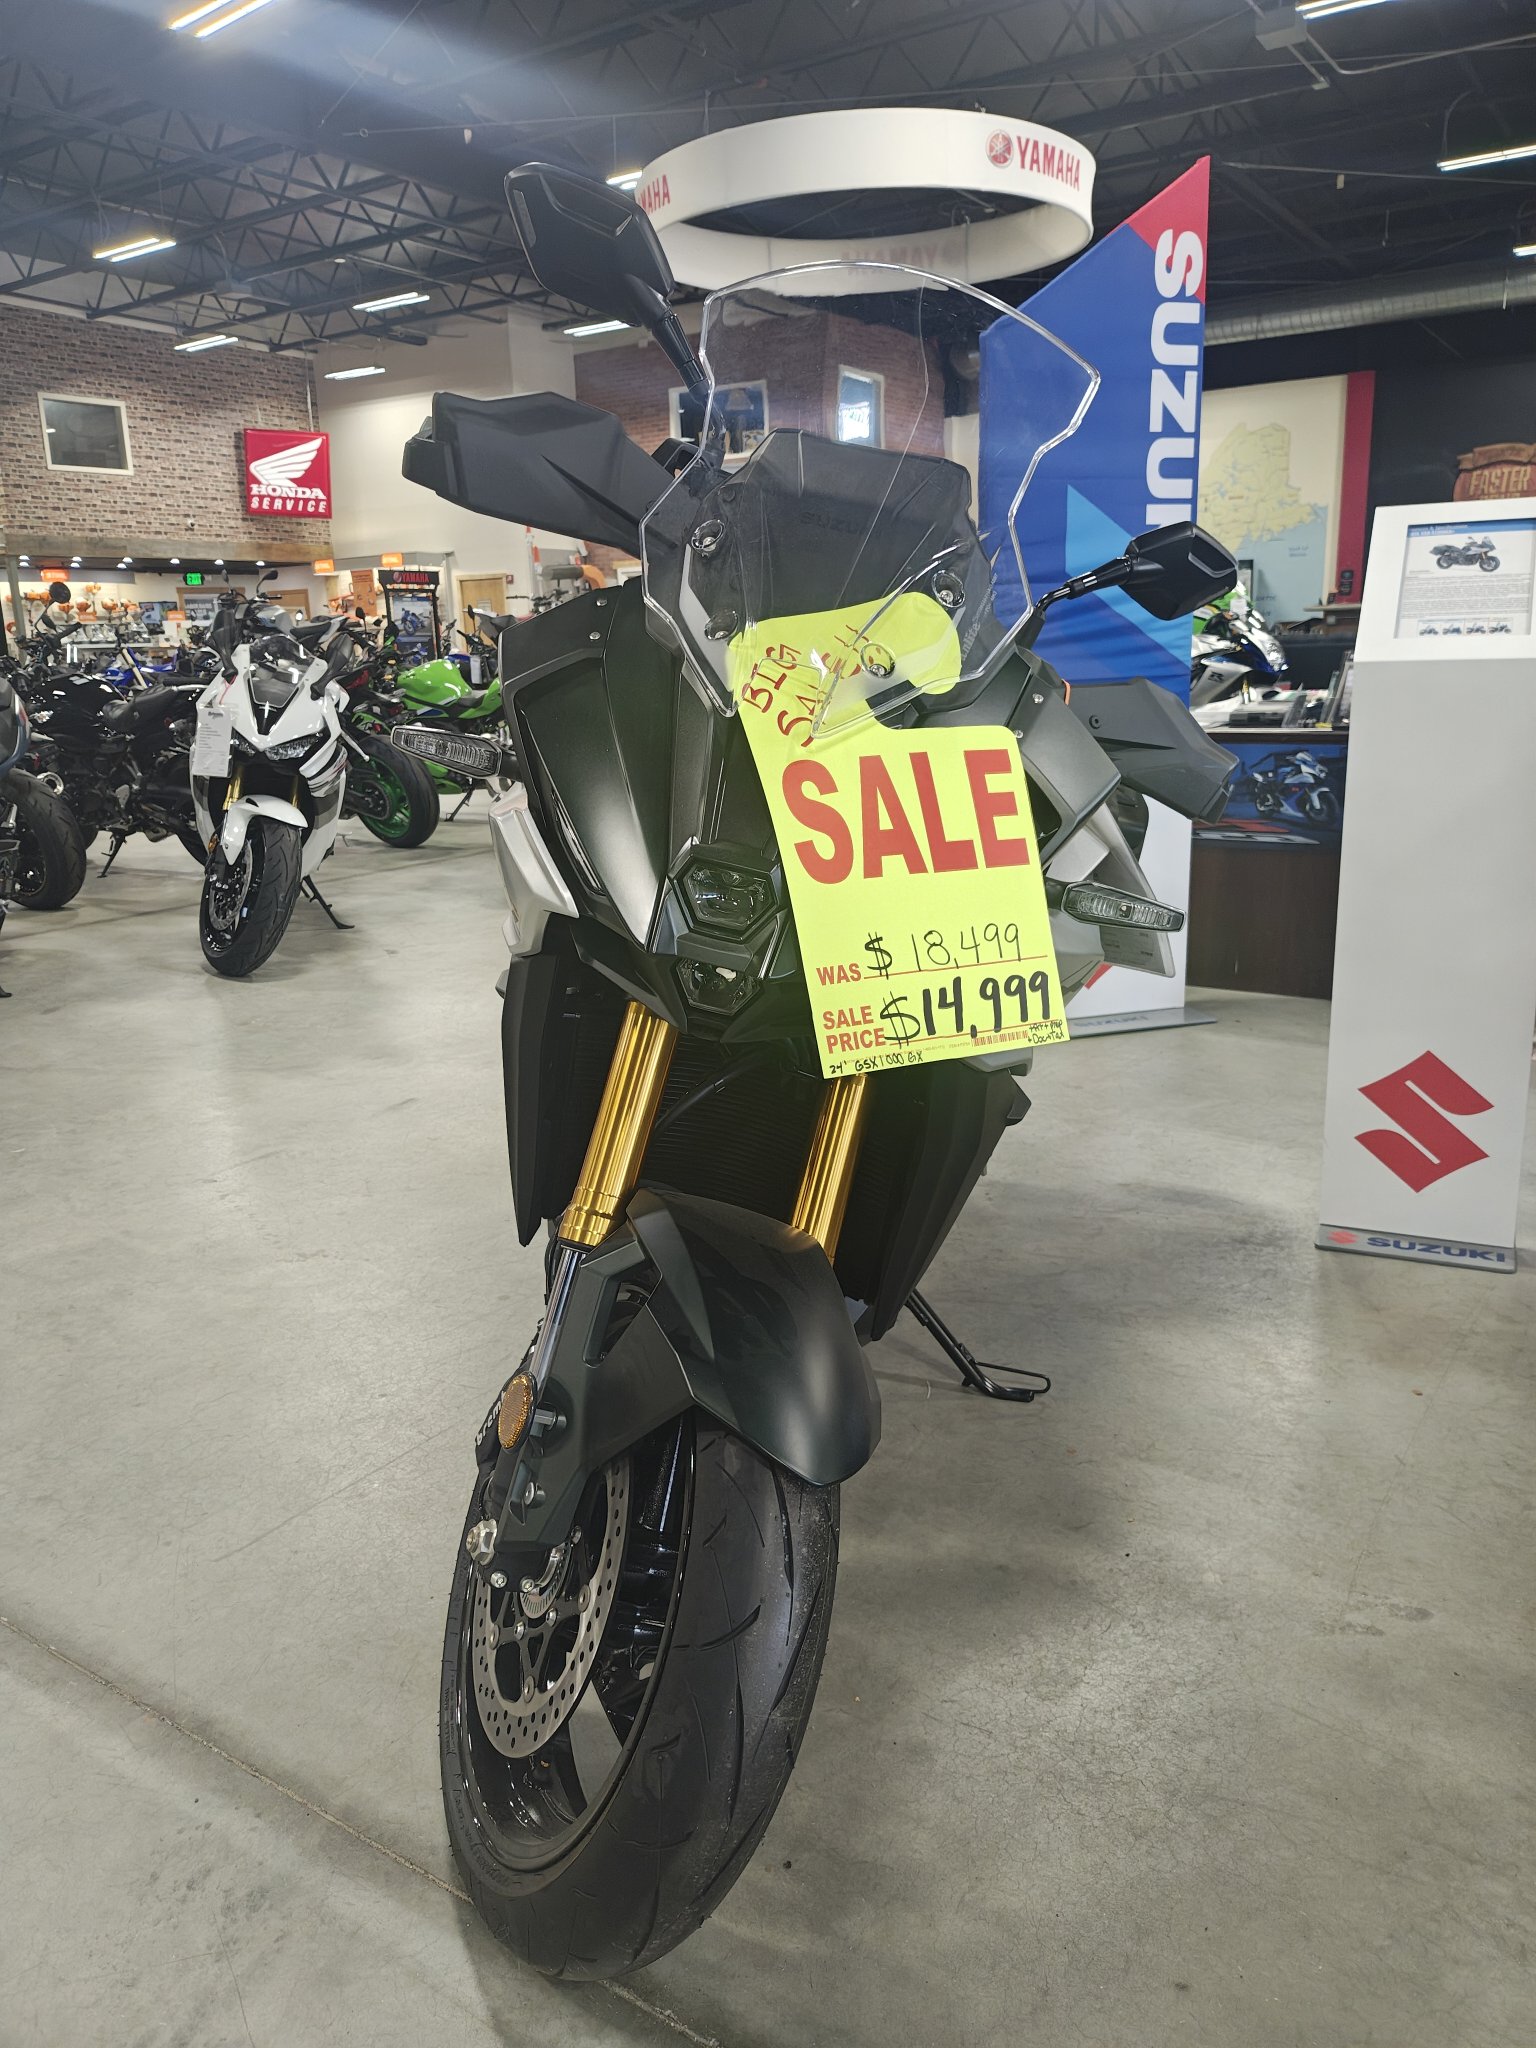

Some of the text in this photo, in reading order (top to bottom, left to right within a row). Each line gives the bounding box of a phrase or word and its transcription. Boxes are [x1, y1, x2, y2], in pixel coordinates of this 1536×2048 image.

[1016, 135, 1080, 192] YAMAHA
[639, 174, 671, 215] MAHA
[249, 483, 327, 500] HONDA
[1468, 465, 1531, 496] FASTER
[250, 496, 327, 513] SERVICE
[402, 571, 430, 584] YAMAHA
[781, 748, 1030, 885] SALE
[816, 923, 1022, 987] WAS $ 18,499
[822, 1005, 875, 1031] SALE
[826, 1027, 886, 1055] PRICE
[1366, 1236, 1506, 1263] SUZUKI
[476, 1390, 506, 1447] brem
